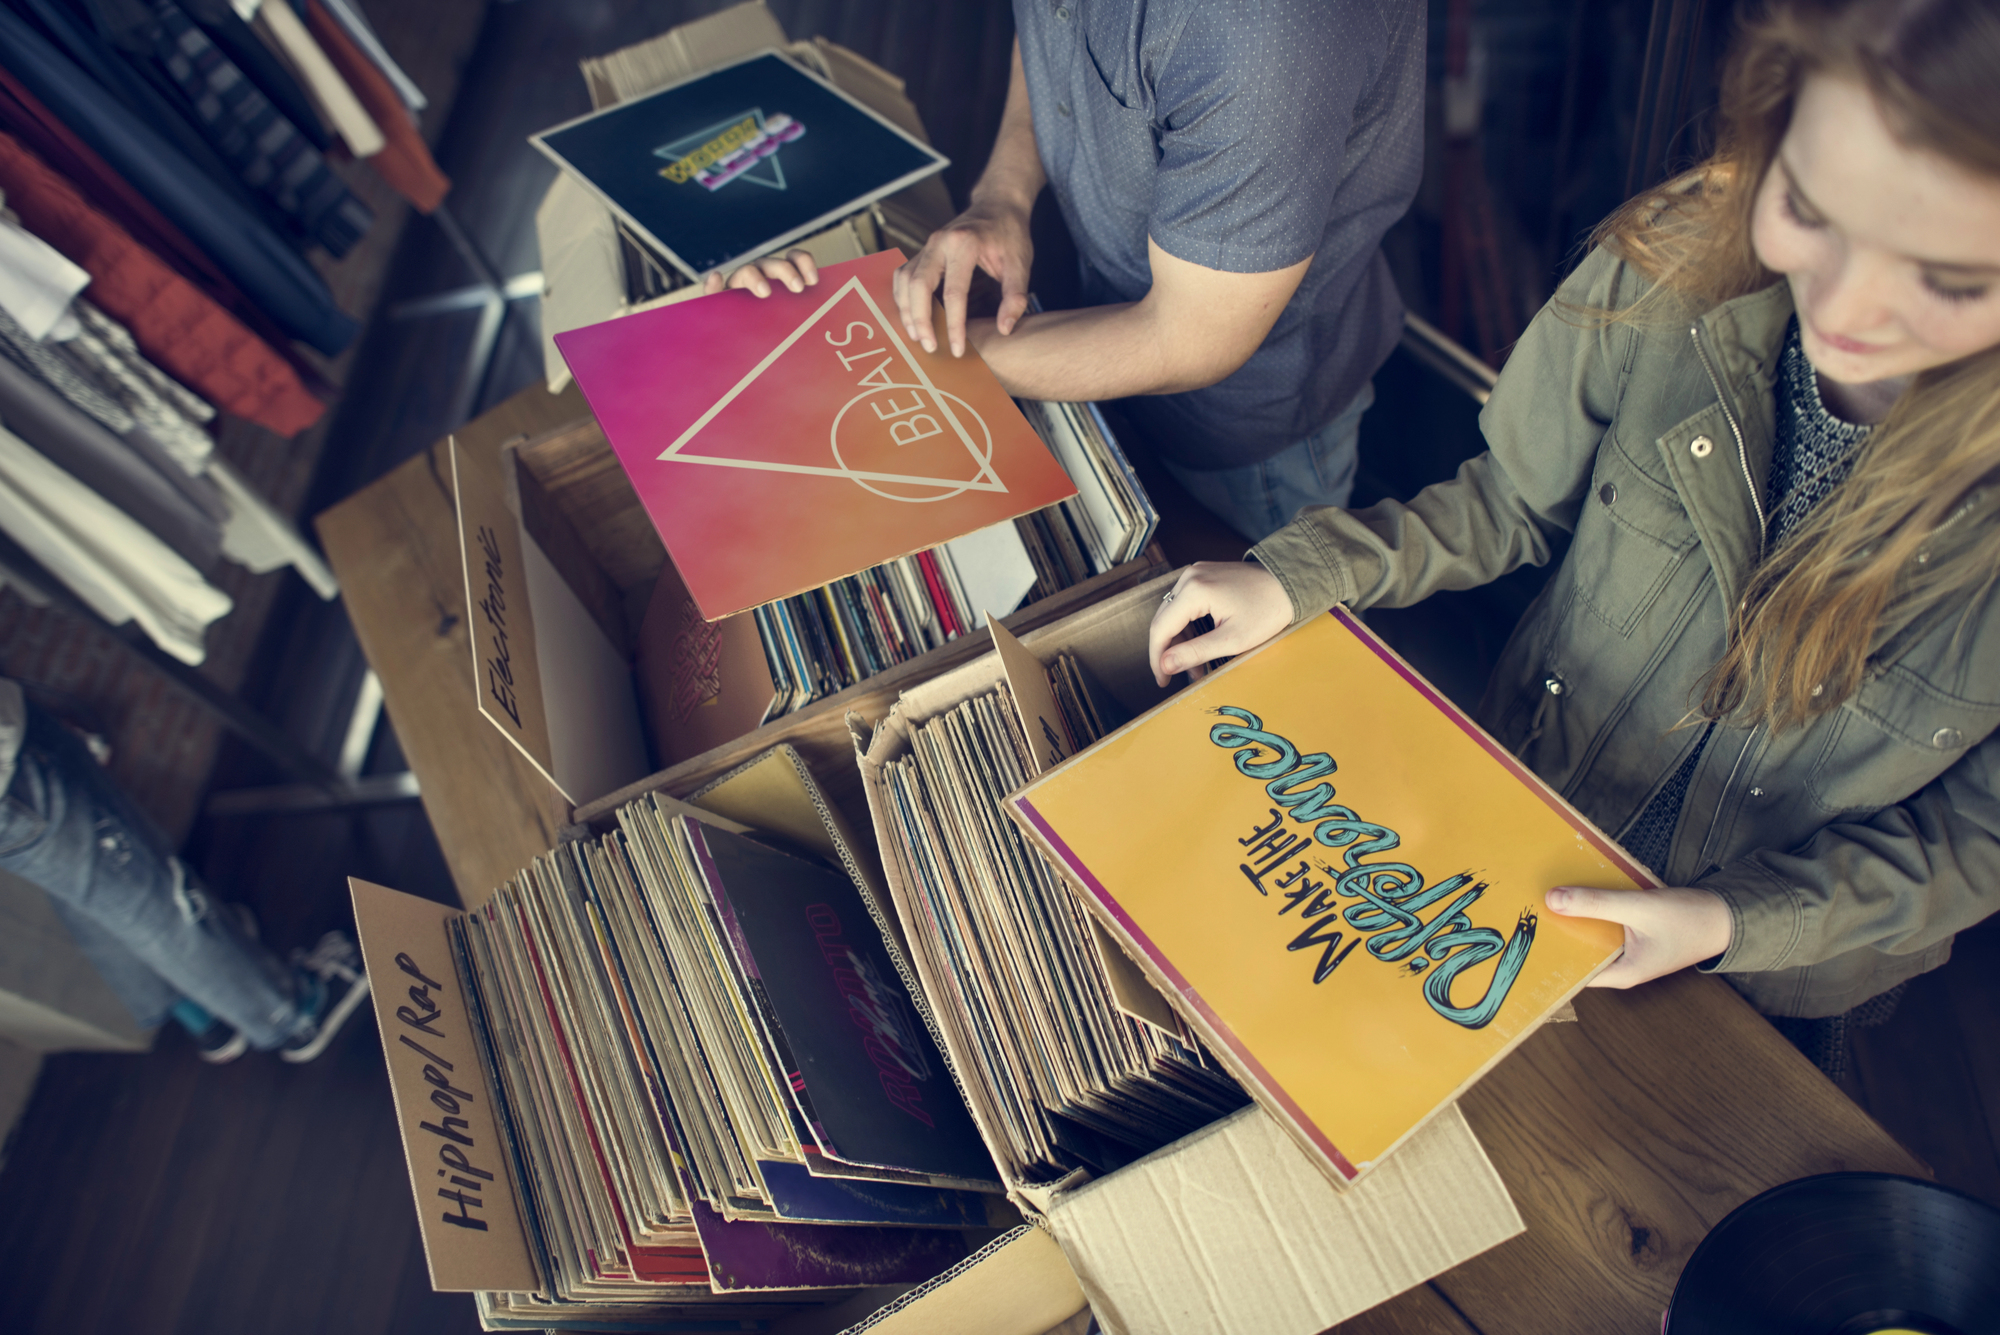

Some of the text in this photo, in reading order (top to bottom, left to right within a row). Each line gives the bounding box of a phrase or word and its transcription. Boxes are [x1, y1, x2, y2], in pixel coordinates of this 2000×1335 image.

[825, 321, 943, 446] BEATS
[477, 525, 522, 729] Electronic
[1209, 705, 1538, 1030] Difference
[1238, 808, 1313, 896] THE
[395, 952, 494, 1231] Hiphop/Rap
